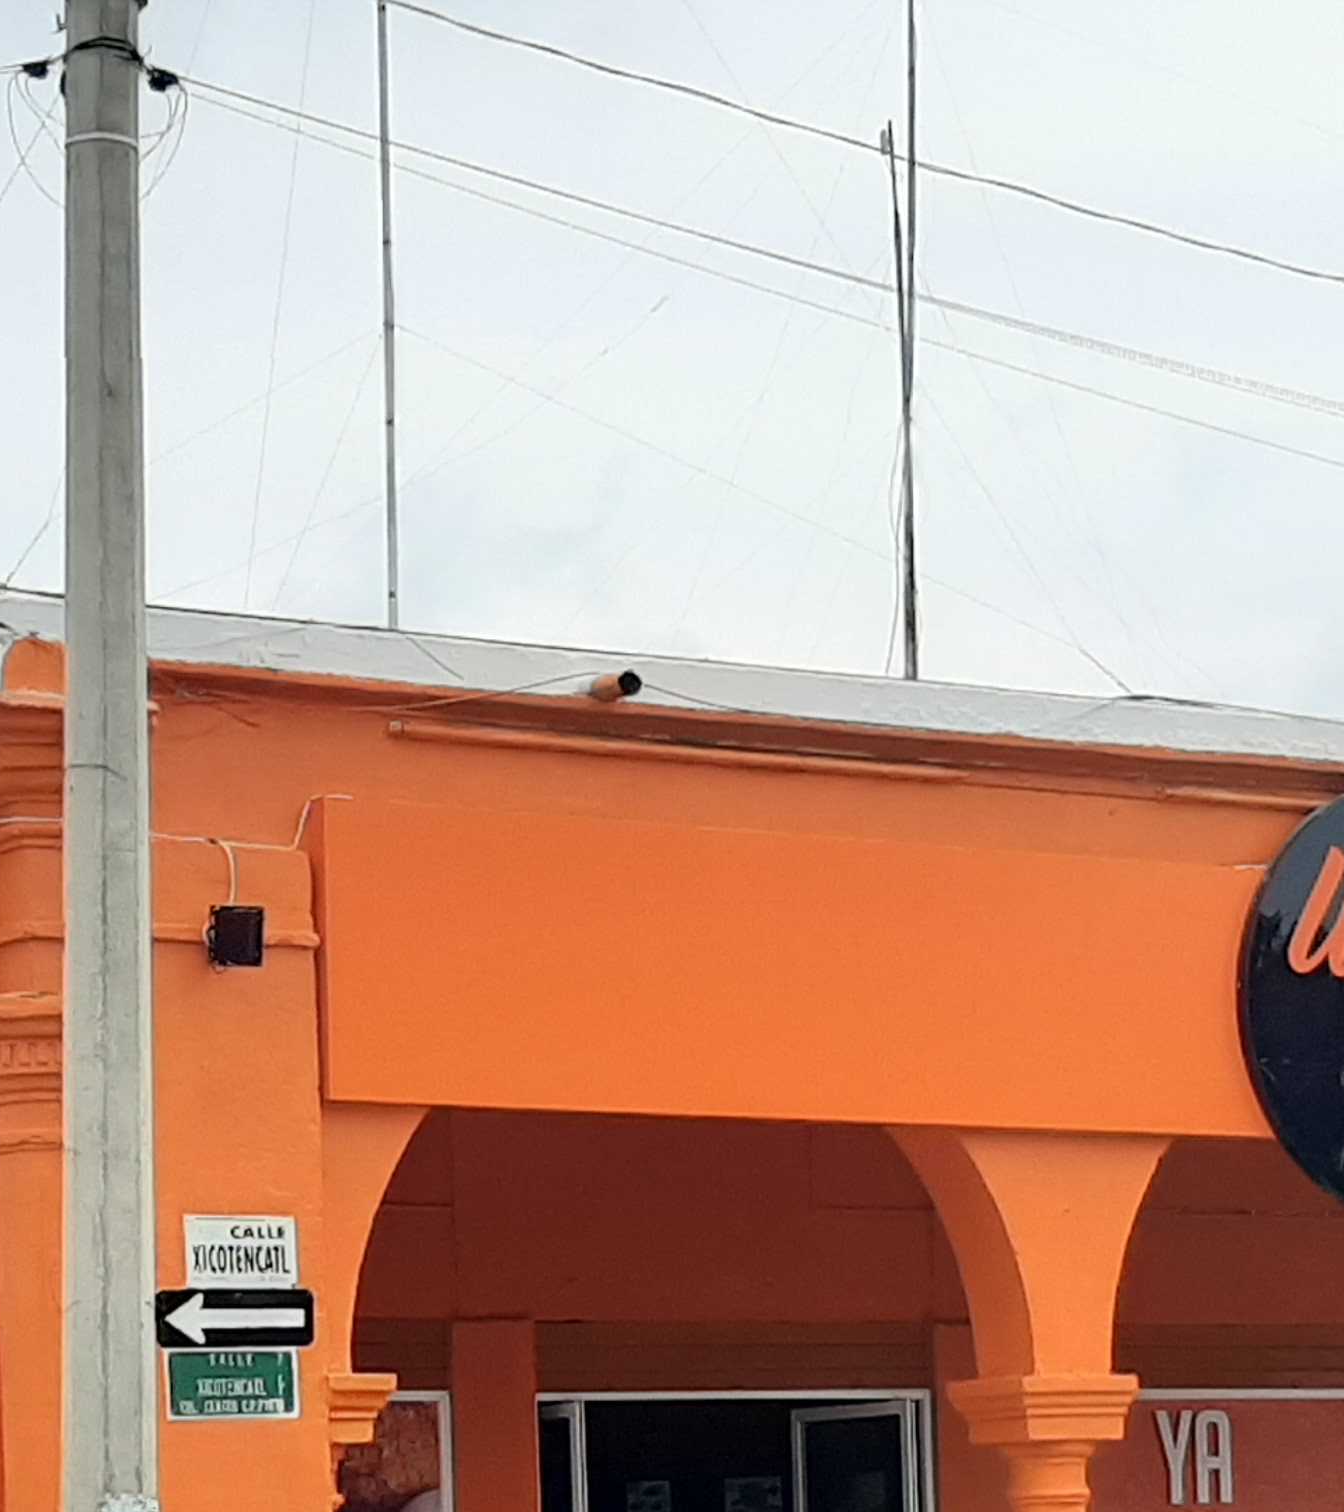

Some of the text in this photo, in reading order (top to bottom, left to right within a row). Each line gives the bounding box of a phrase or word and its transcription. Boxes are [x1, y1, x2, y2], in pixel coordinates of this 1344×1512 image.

[230, 1223, 286, 1239] CALLE
[192, 1244, 291, 1274] XICOTENCATL
[1155, 1409, 1234, 1504] YA
